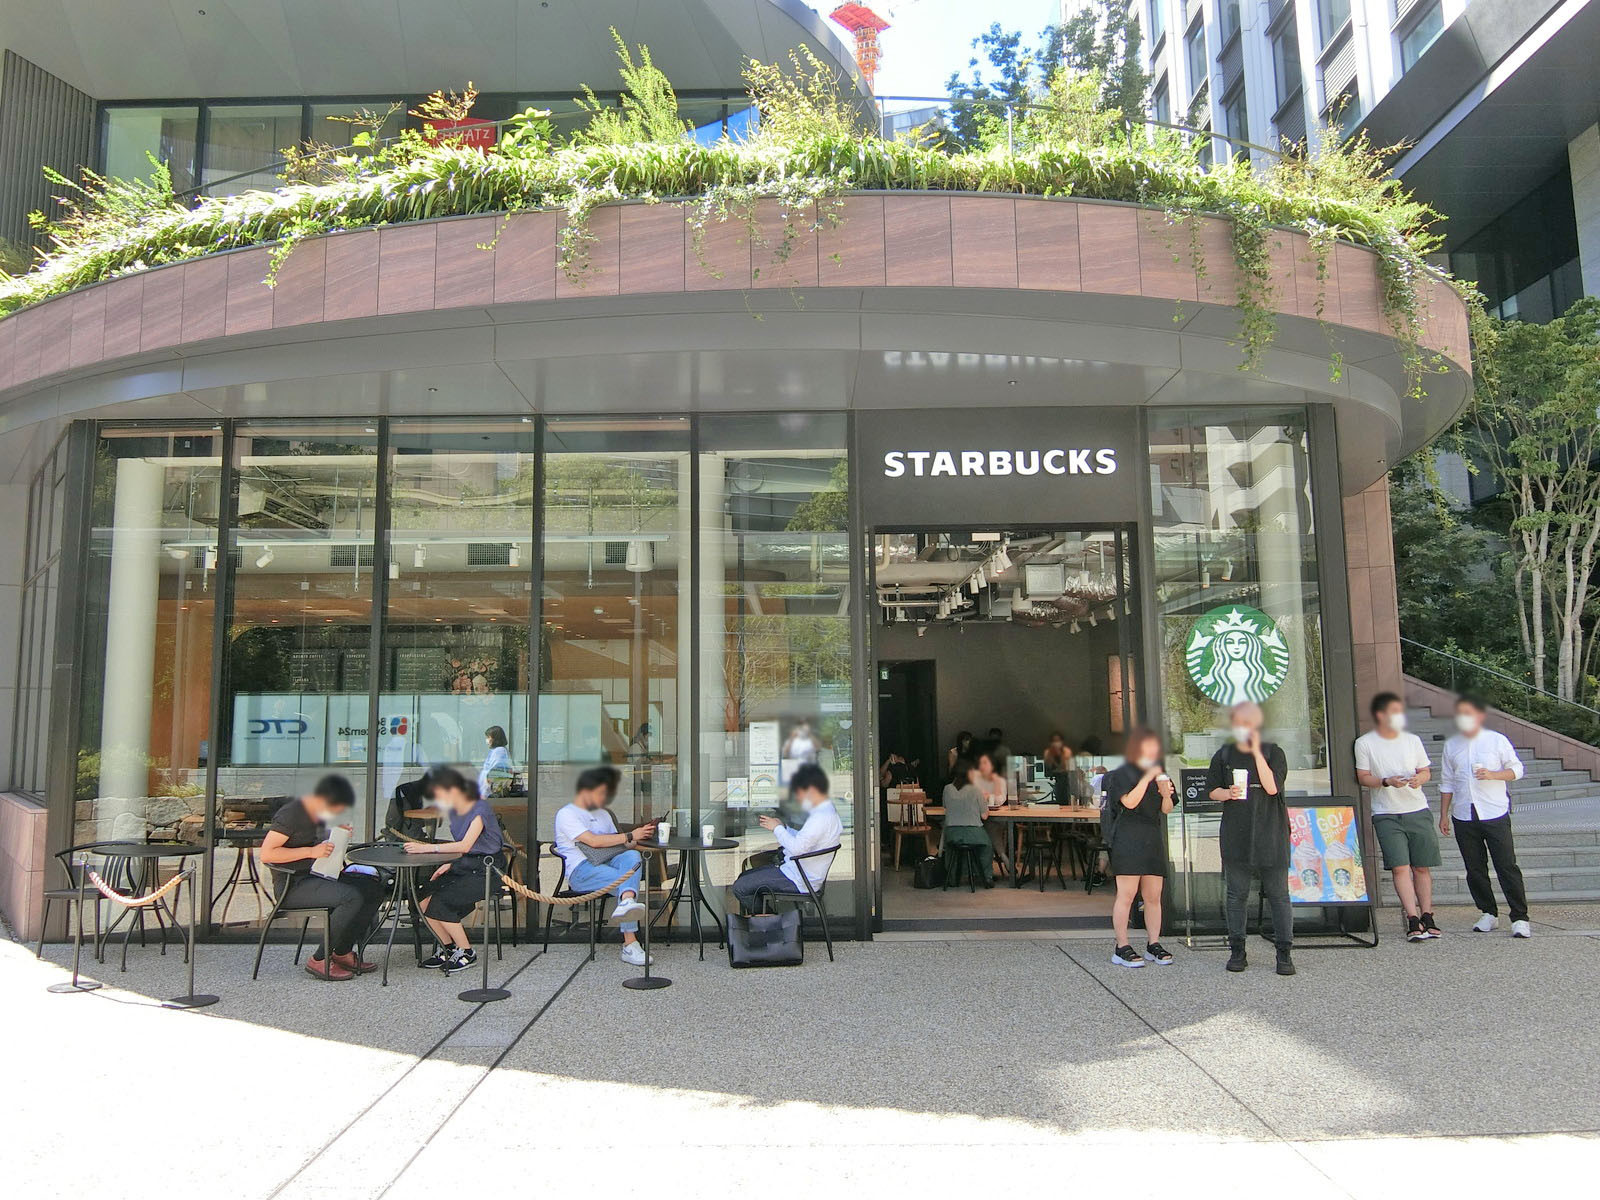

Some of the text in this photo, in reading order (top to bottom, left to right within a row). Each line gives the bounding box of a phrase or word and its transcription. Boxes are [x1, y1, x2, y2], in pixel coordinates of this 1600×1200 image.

[434, 127, 490, 143] CHMATZ
[884, 448, 1118, 477] STARBUCKS
[1316, 811, 1344, 832] GO!
